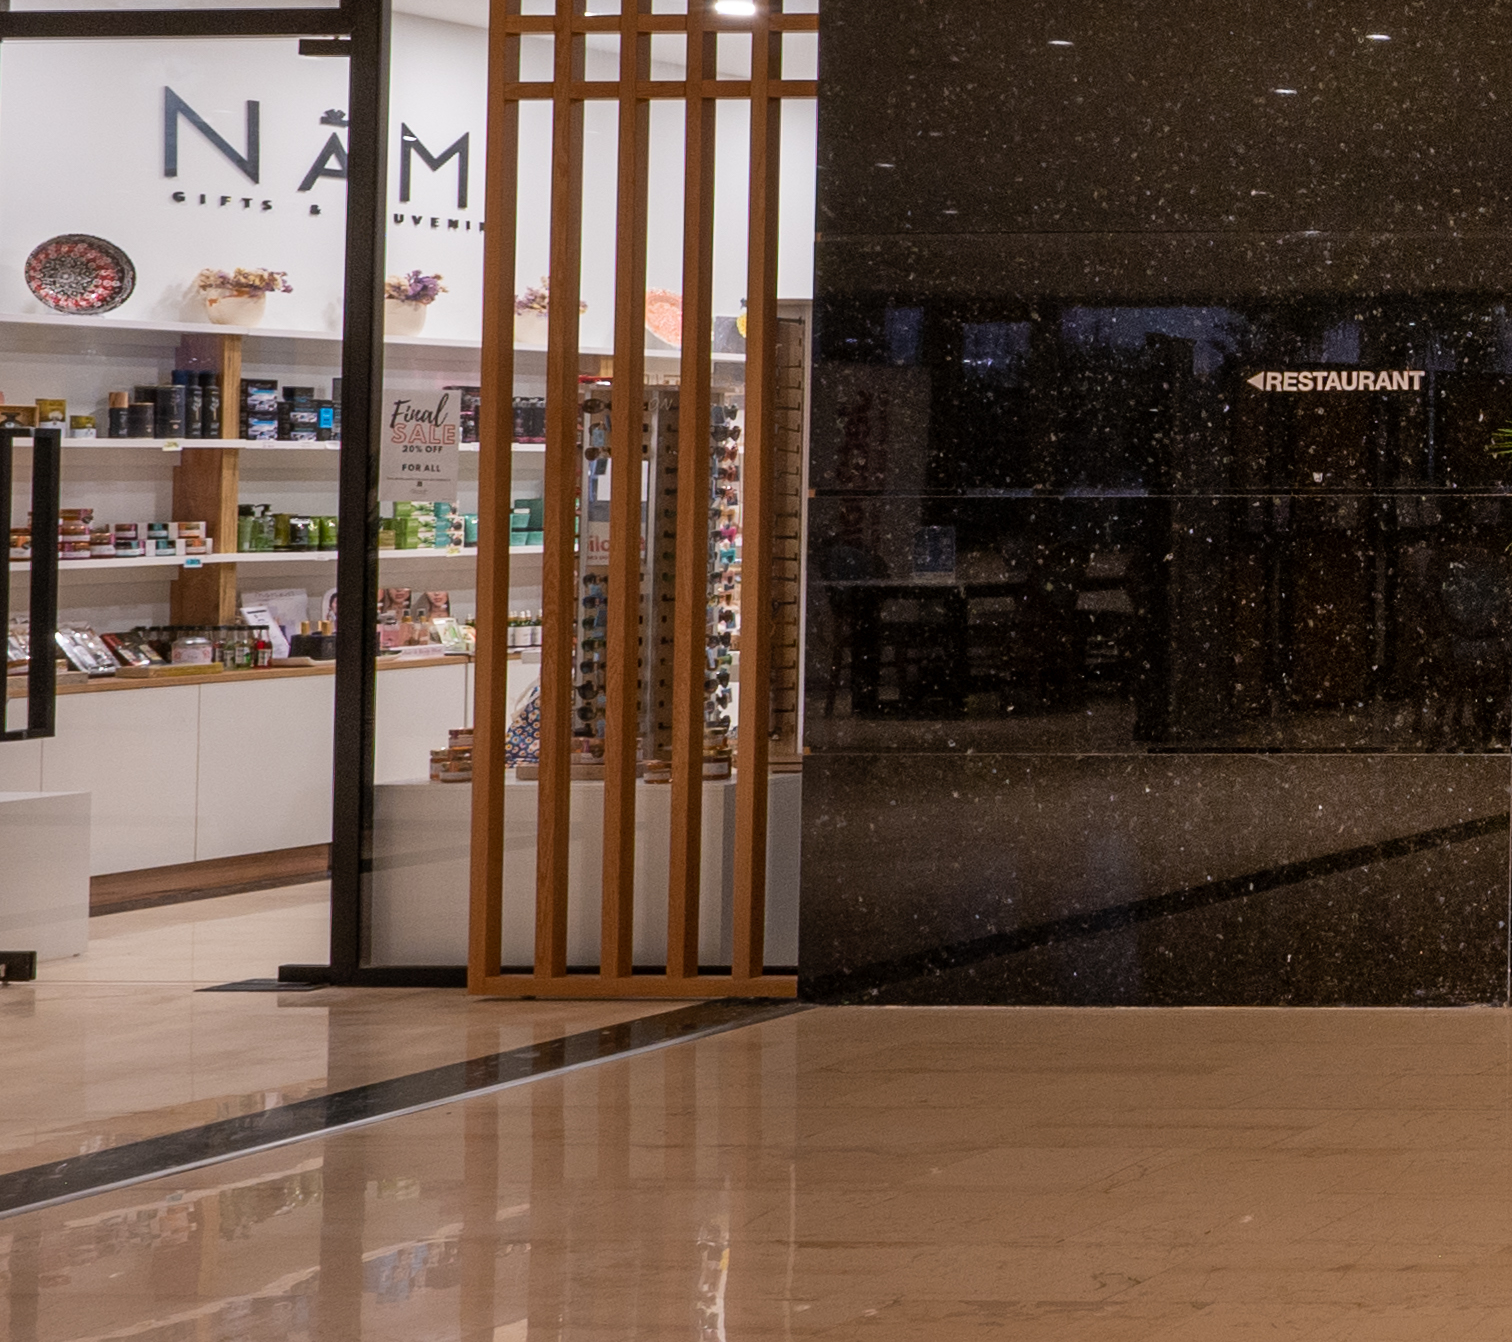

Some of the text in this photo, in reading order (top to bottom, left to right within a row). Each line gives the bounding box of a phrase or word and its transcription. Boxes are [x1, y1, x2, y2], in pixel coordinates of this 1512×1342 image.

[172, 191, 273, 211] GIFTS
[309, 204, 321, 216] &
[1265, 370, 1426, 392] RESTAURANT
[390, 393, 449, 428] Final
[391, 422, 456, 445] SALE
[402, 445, 422, 453] 20%
[401, 464, 441, 472] FOR ALL
